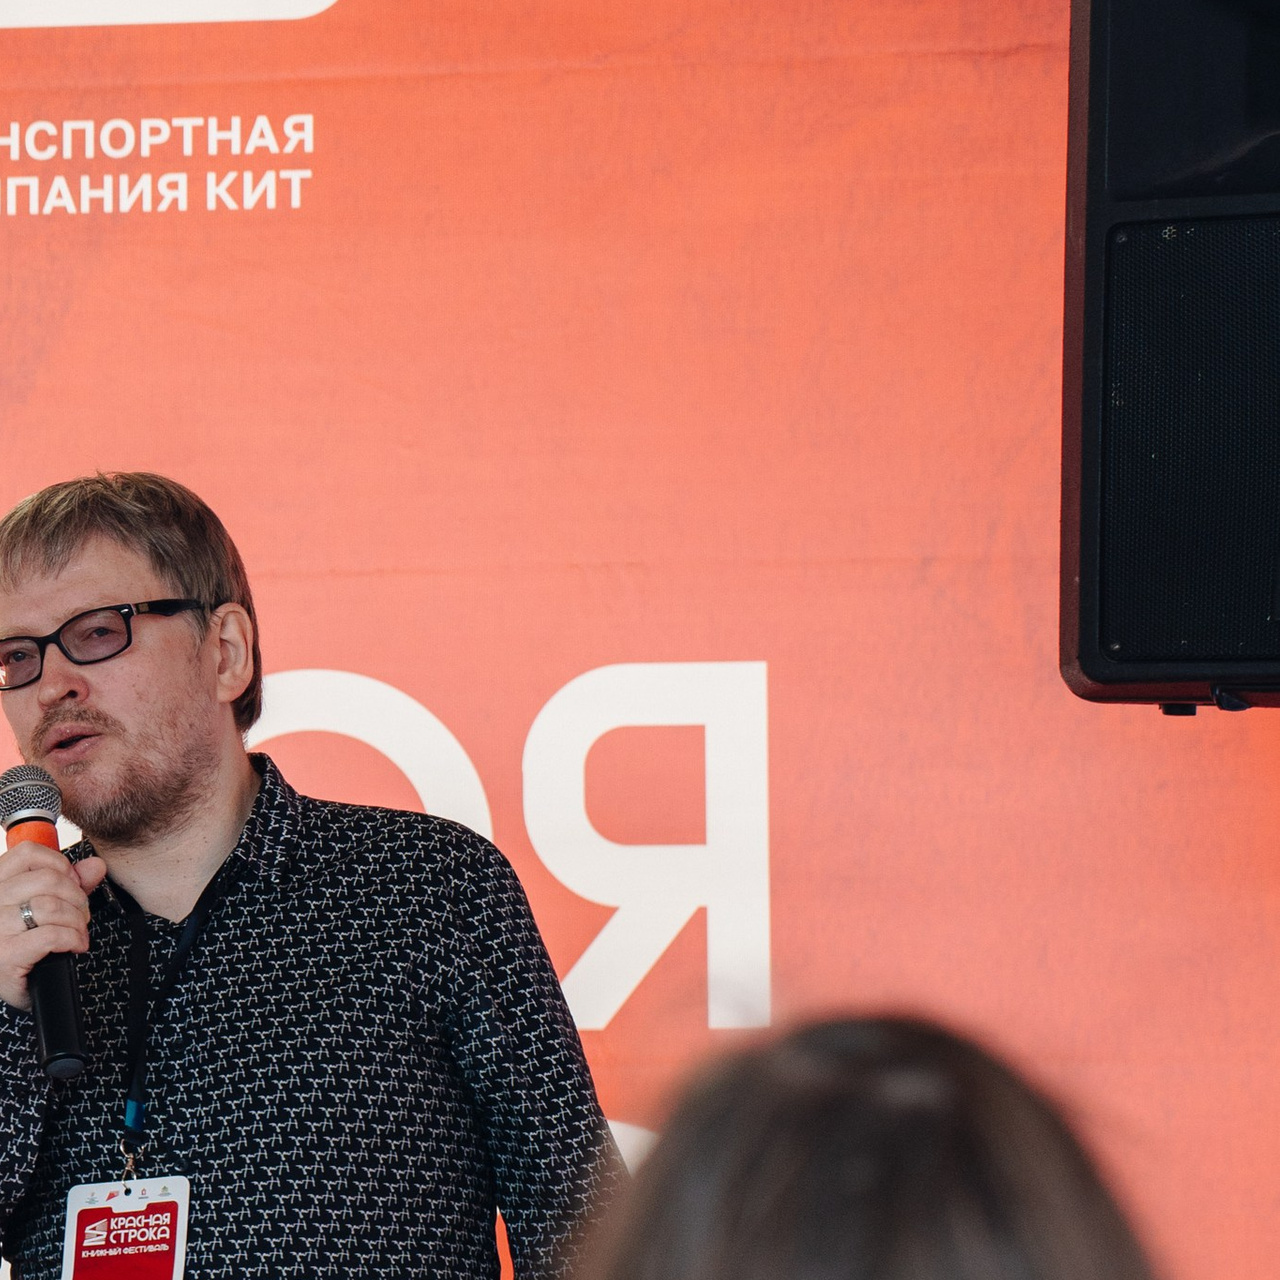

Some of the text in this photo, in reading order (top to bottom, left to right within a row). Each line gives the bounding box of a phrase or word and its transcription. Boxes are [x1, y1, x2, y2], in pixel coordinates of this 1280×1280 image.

[205, 168, 313, 211] КИТ
[110, 1212, 171, 1230] КРАСНАЯ
[109, 1226, 171, 1245] СТРОКА
[81, 1243, 170, 1259] КНИЖНЫЙ ФЕСТИВАЛЬ
